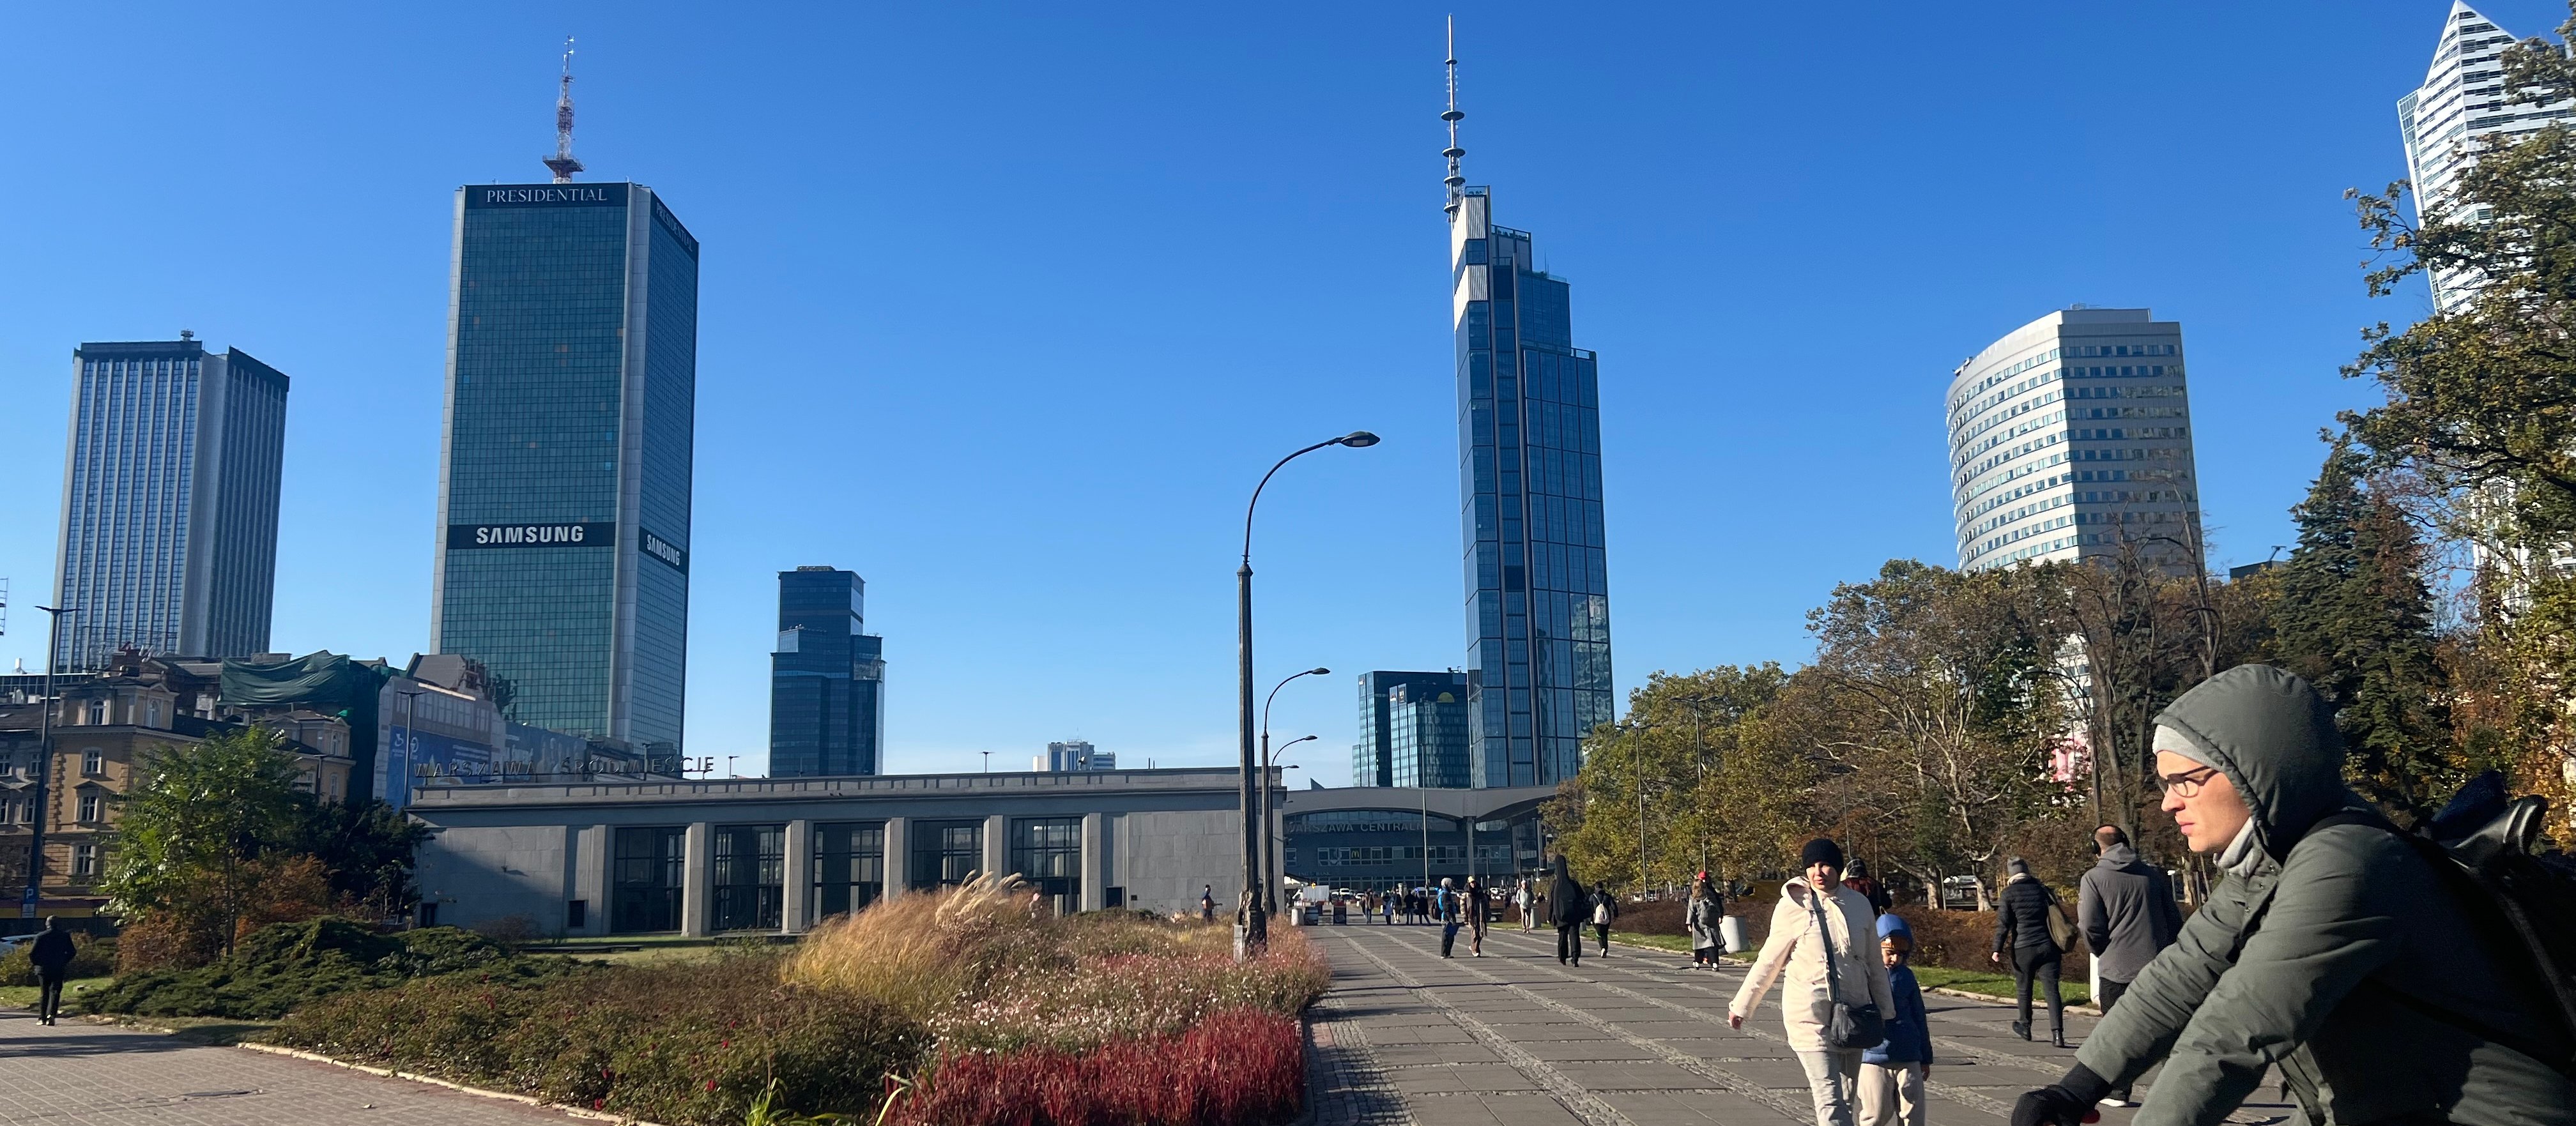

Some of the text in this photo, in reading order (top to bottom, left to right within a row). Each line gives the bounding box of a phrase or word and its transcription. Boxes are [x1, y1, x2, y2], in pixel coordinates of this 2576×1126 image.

[487, 188, 608, 202] PRESIDENTIAL
[656, 202, 693, 252] PRESIDENTIAL
[476, 526, 584, 544] SAMSUNG
[647, 534, 680, 566] SAMSUNG
[413, 761, 537, 777] WARSZAWA
[1285, 822, 1432, 833] WARSZAWA CENTRALNA
[26, 888, 34, 899] P
